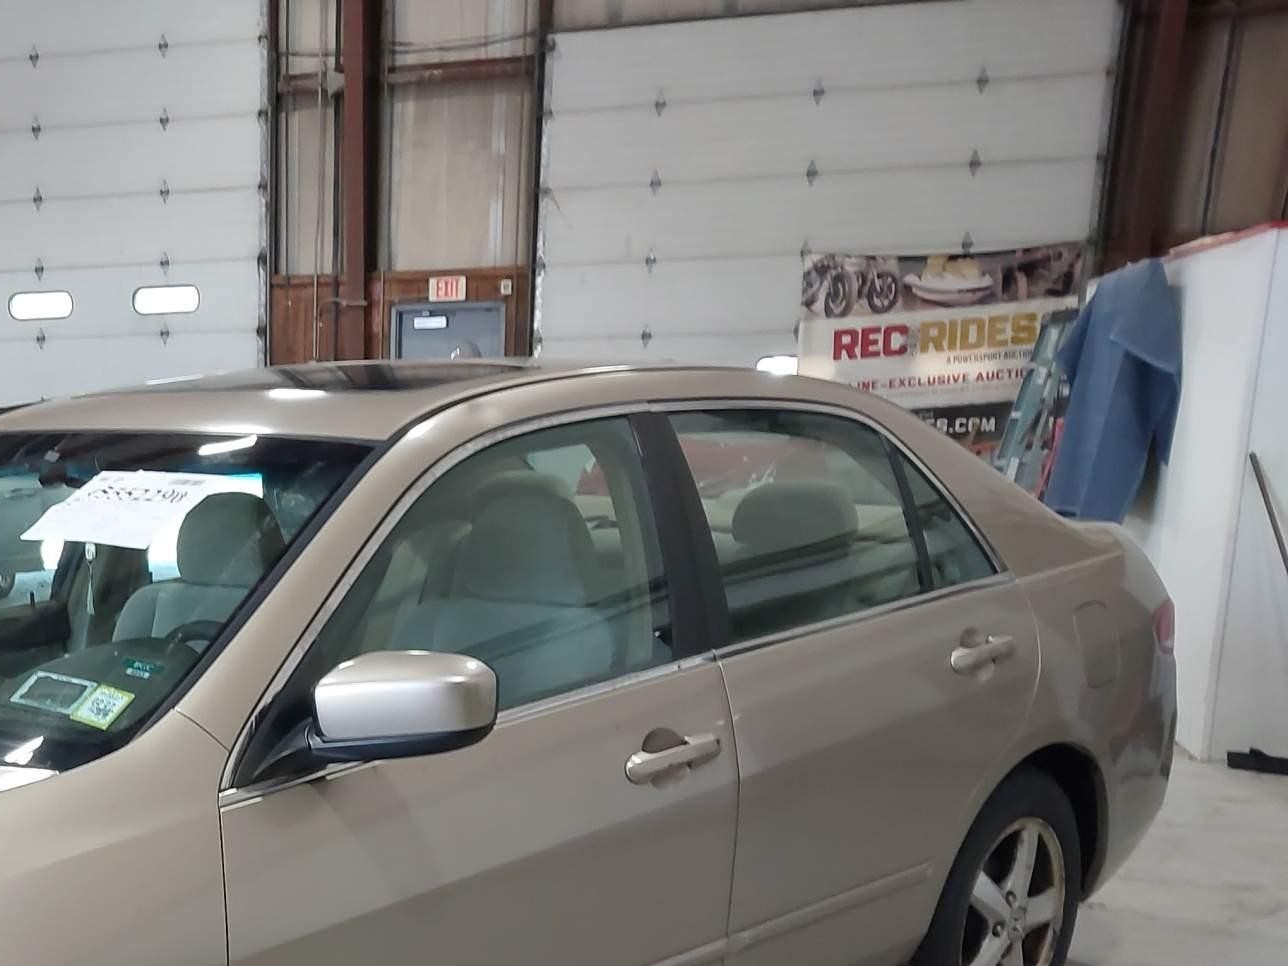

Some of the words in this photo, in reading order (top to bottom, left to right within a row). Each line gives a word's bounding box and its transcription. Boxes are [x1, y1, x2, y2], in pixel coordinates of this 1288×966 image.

[436, 279, 461, 298] EXIT
[833, 324, 909, 361] REC
[919, 312, 1038, 354] RIDES
